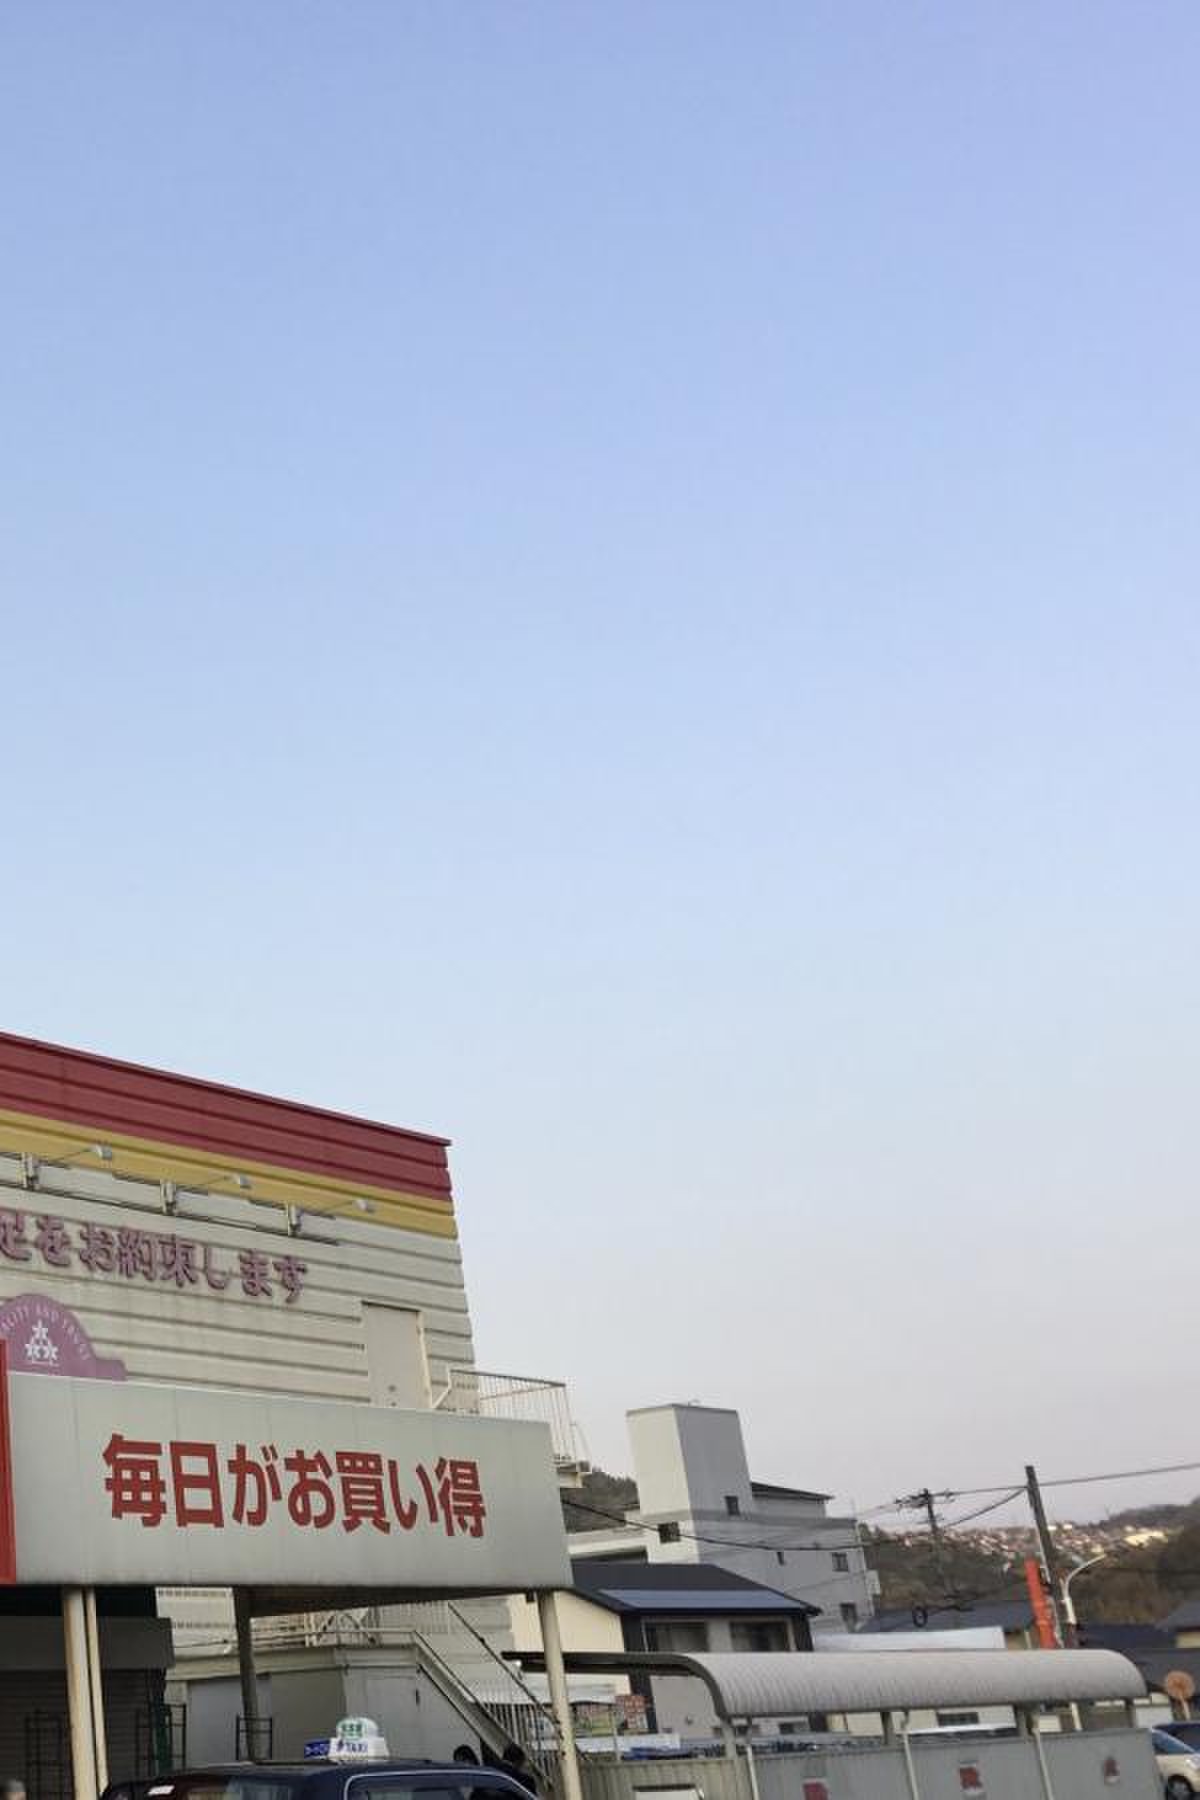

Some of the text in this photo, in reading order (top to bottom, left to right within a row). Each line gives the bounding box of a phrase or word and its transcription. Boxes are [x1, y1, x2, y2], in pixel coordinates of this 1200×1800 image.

[101, 1432, 488, 1539] 毎日がお買い得
